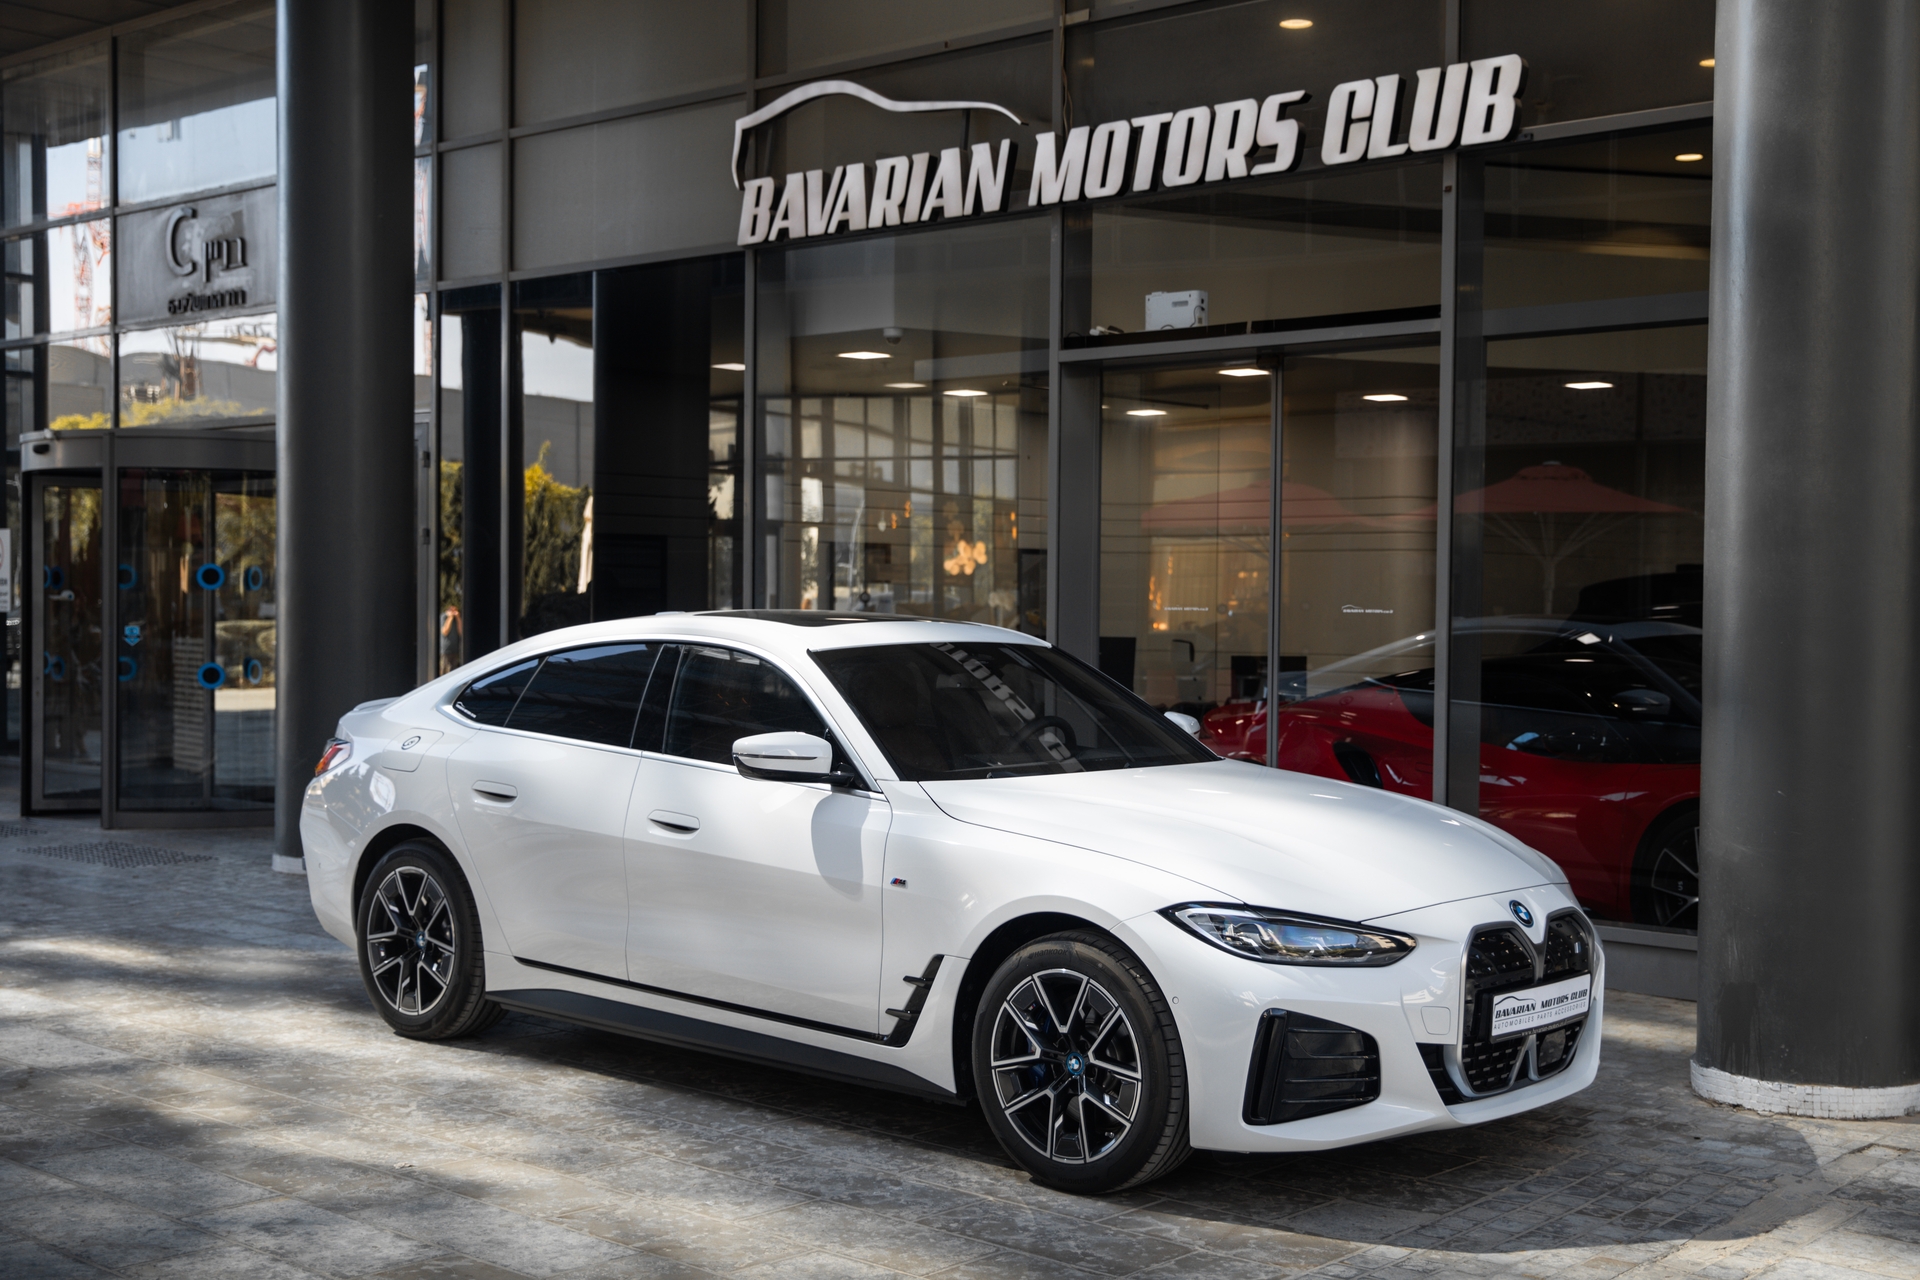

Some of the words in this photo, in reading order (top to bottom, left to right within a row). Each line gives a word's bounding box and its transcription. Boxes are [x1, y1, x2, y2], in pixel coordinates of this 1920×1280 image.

[737, 139, 1012, 247] BAVARIAN
[1028, 90, 1308, 206] MOTORS
[1321, 53, 1524, 165] CLUB
[165, 206, 197, 276] C
[1493, 1015, 1534, 1030] AUTOMOBILES
[1536, 1011, 1553, 1020] PARTS
[1554, 1001, 1586, 1016] ACCESSORIES
[1495, 1002, 1536, 1019] BAVARIAN
[1540, 993, 1569, 1009] MOTORS
[1570, 988, 1588, 1001] CLUB
